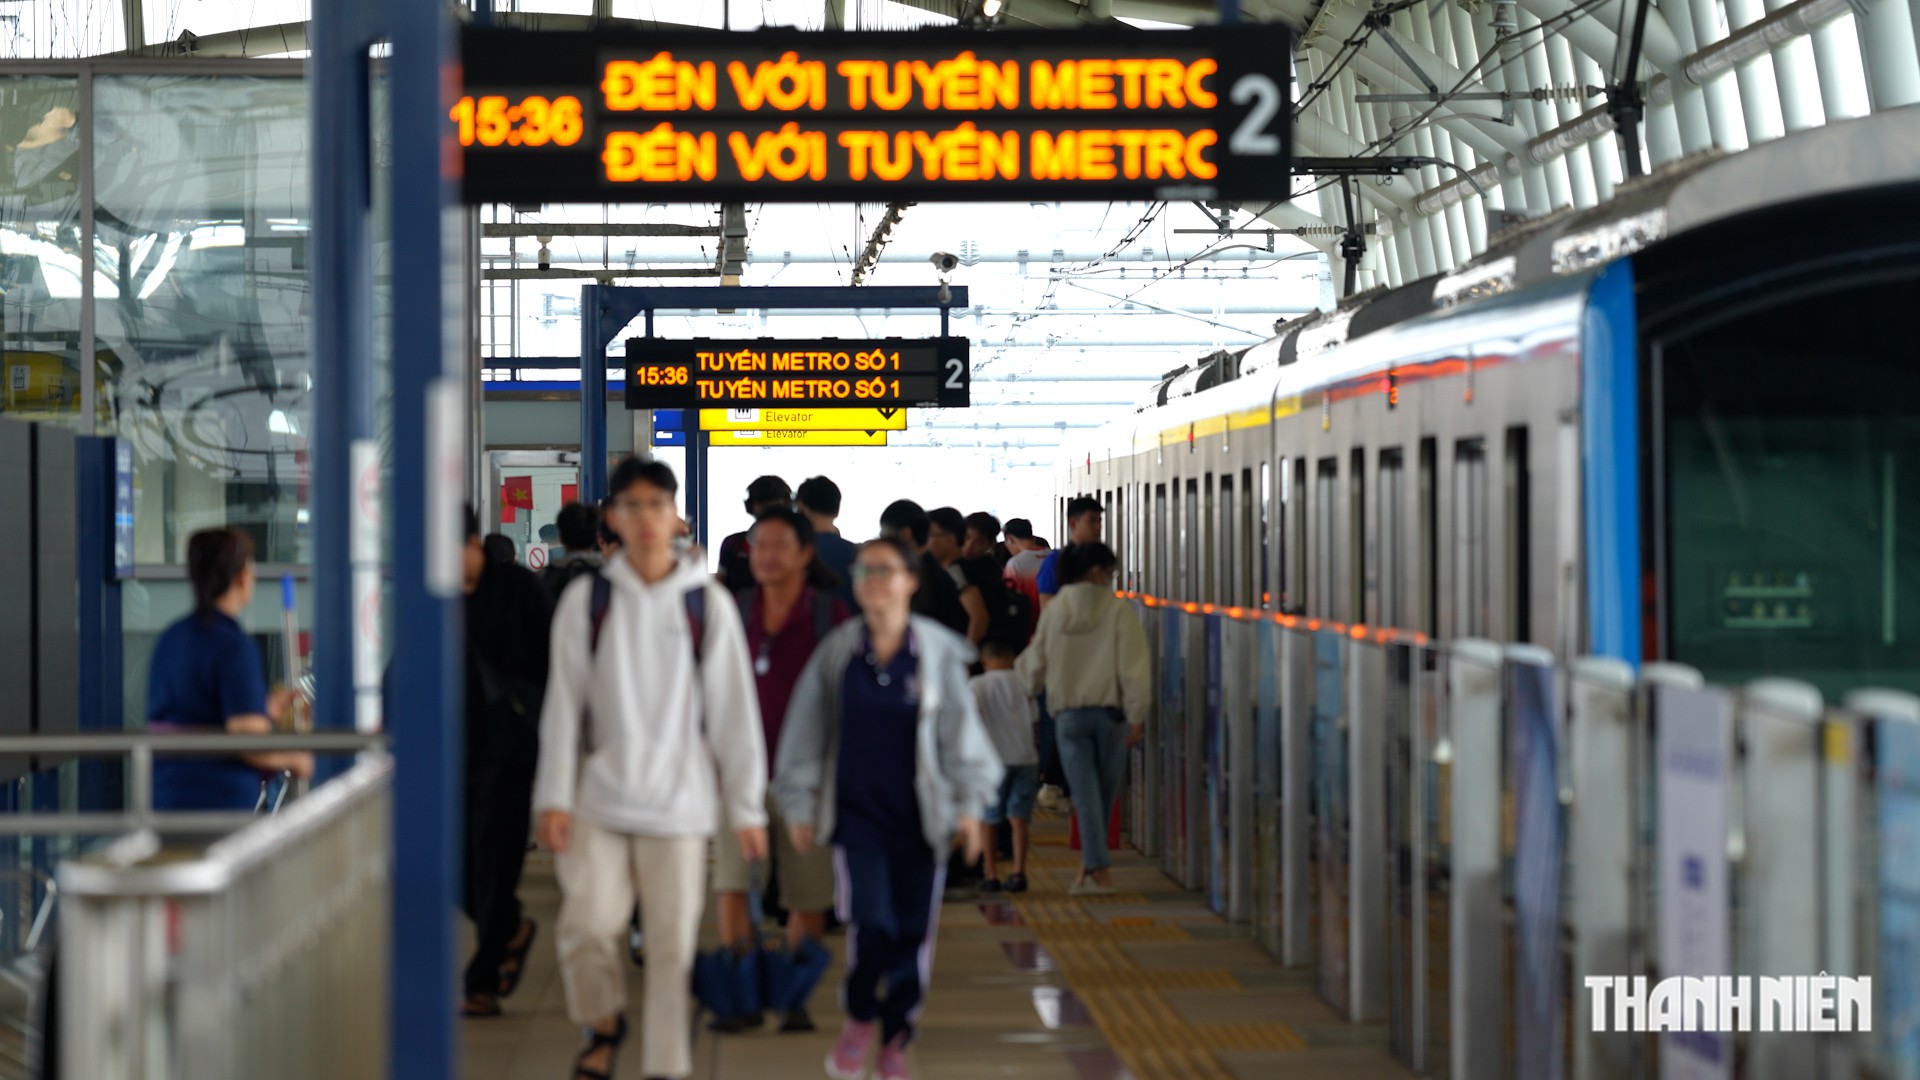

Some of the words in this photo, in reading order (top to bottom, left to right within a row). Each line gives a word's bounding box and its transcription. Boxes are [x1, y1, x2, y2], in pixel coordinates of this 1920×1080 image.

[449, 96, 583, 146] 15:36
[1229, 73, 1281, 156] 2
[772, 352, 850, 370] METRO
[890, 352, 899, 370] 1
[637, 366, 688, 385] 15:36
[945, 358, 963, 389] 2
[773, 380, 850, 398] METRO
[890, 380, 899, 398] 1
[765, 411, 813, 422] Elevator
